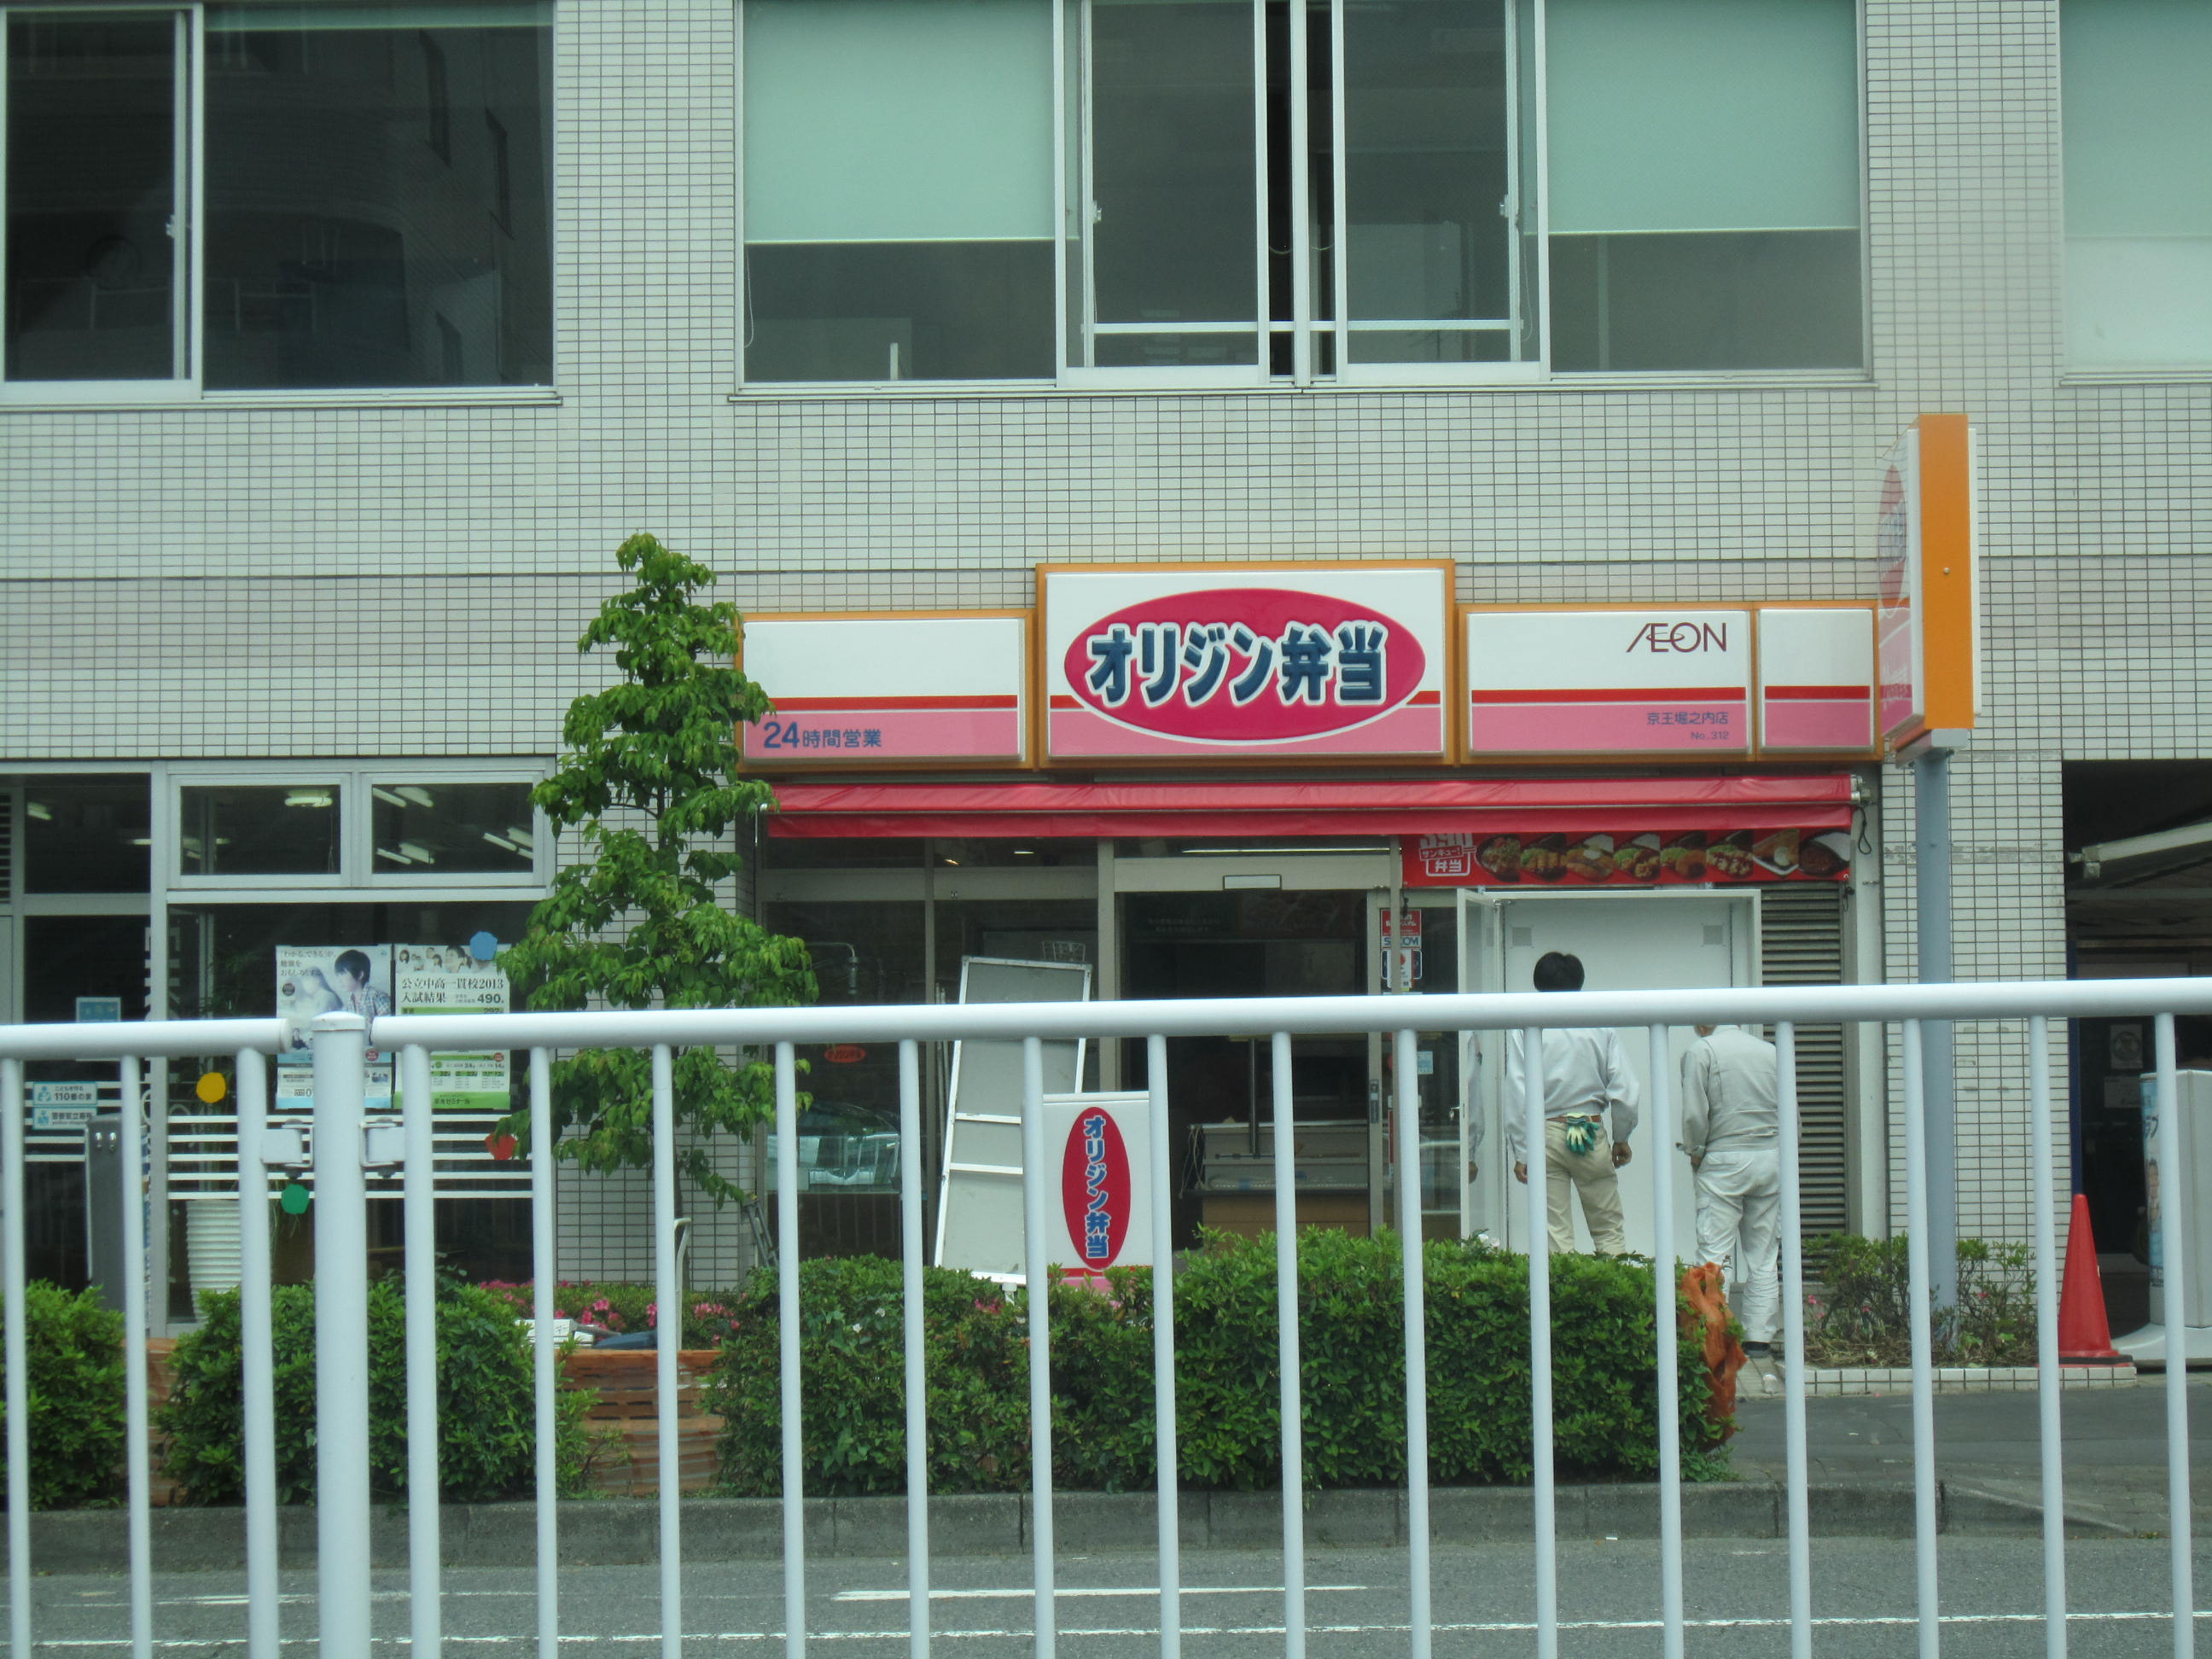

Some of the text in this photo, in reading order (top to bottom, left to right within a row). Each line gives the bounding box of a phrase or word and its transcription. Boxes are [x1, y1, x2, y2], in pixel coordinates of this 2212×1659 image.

[1086, 622, 1387, 707] オリジン弁当
[1647, 712, 1728, 725] 京王堀之内店
[764, 721, 882, 748] 24時間営業
[1434, 859, 1462, 873] 弁当
[1384, 937, 1419, 946] SOM
[402, 976, 504, 990] 公立中高一貫校2013
[401, 991, 446, 1004] 入試結果
[54, 1092, 92, 1101] 110番の家
[1083, 1115, 1111, 1259] オリジン弁当
